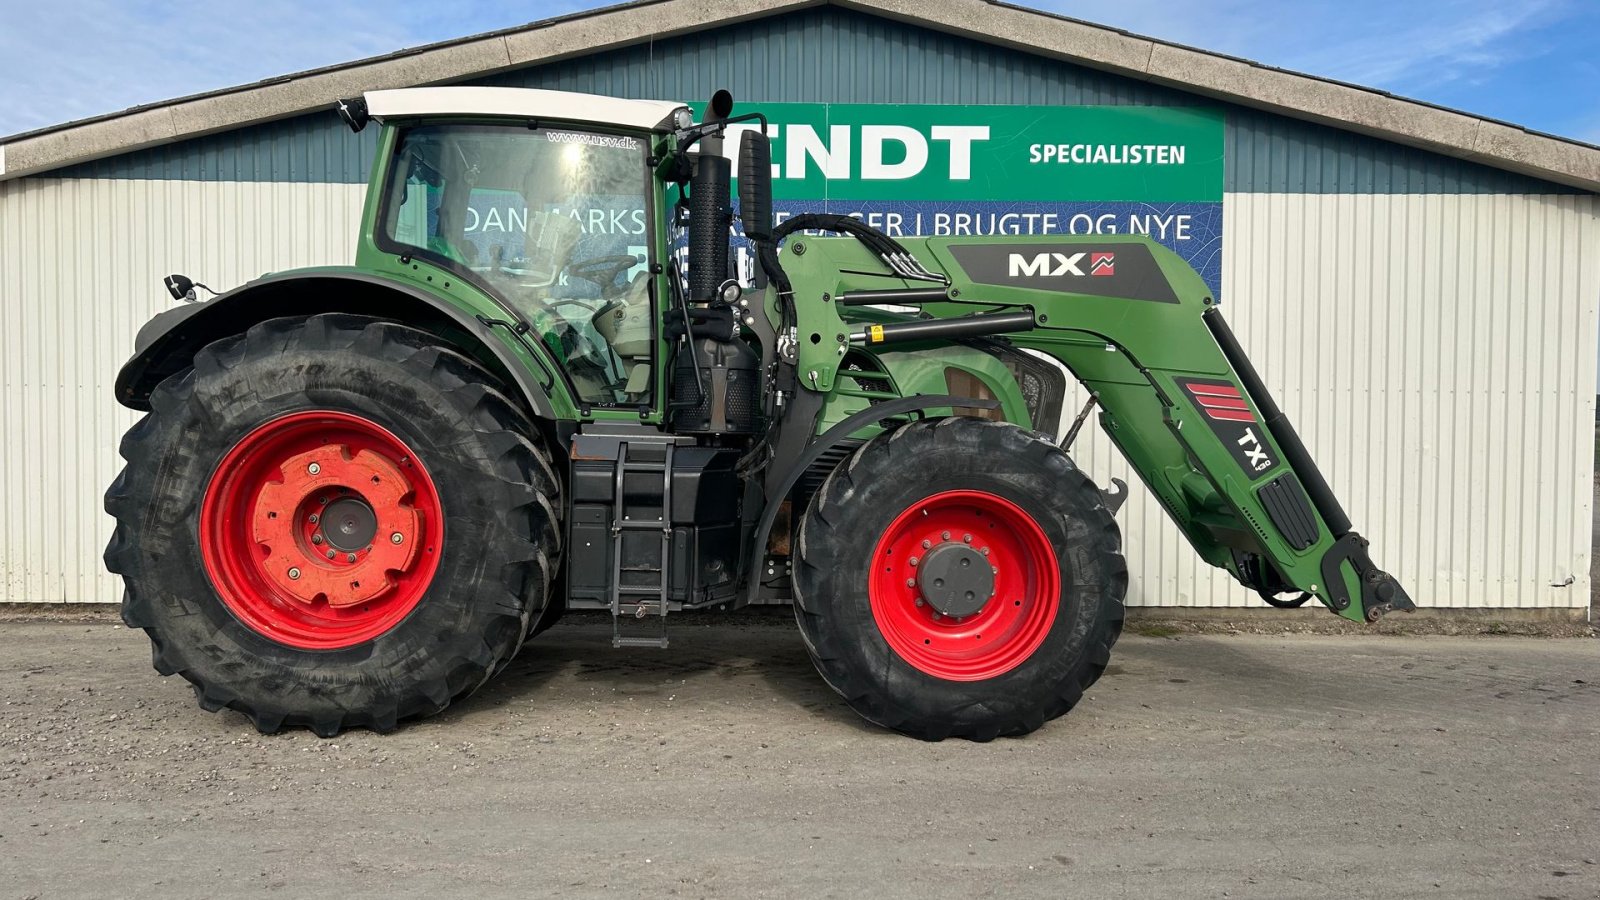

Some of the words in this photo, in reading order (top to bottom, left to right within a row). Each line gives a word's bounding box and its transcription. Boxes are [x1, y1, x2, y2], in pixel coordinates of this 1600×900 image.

[546, 132, 637, 149] www.usv.dk
[687, 122, 990, 179] ENDT
[1030, 144, 1185, 164] SPECIALISTEN
[464, 207, 646, 235] DANARKS
[934, 213, 1057, 236] BRUGTE
[1069, 214, 1117, 235] OG
[1130, 214, 1191, 240] NYE
[1009, 253, 1087, 276] MX
[1238, 427, 1268, 467] TX
